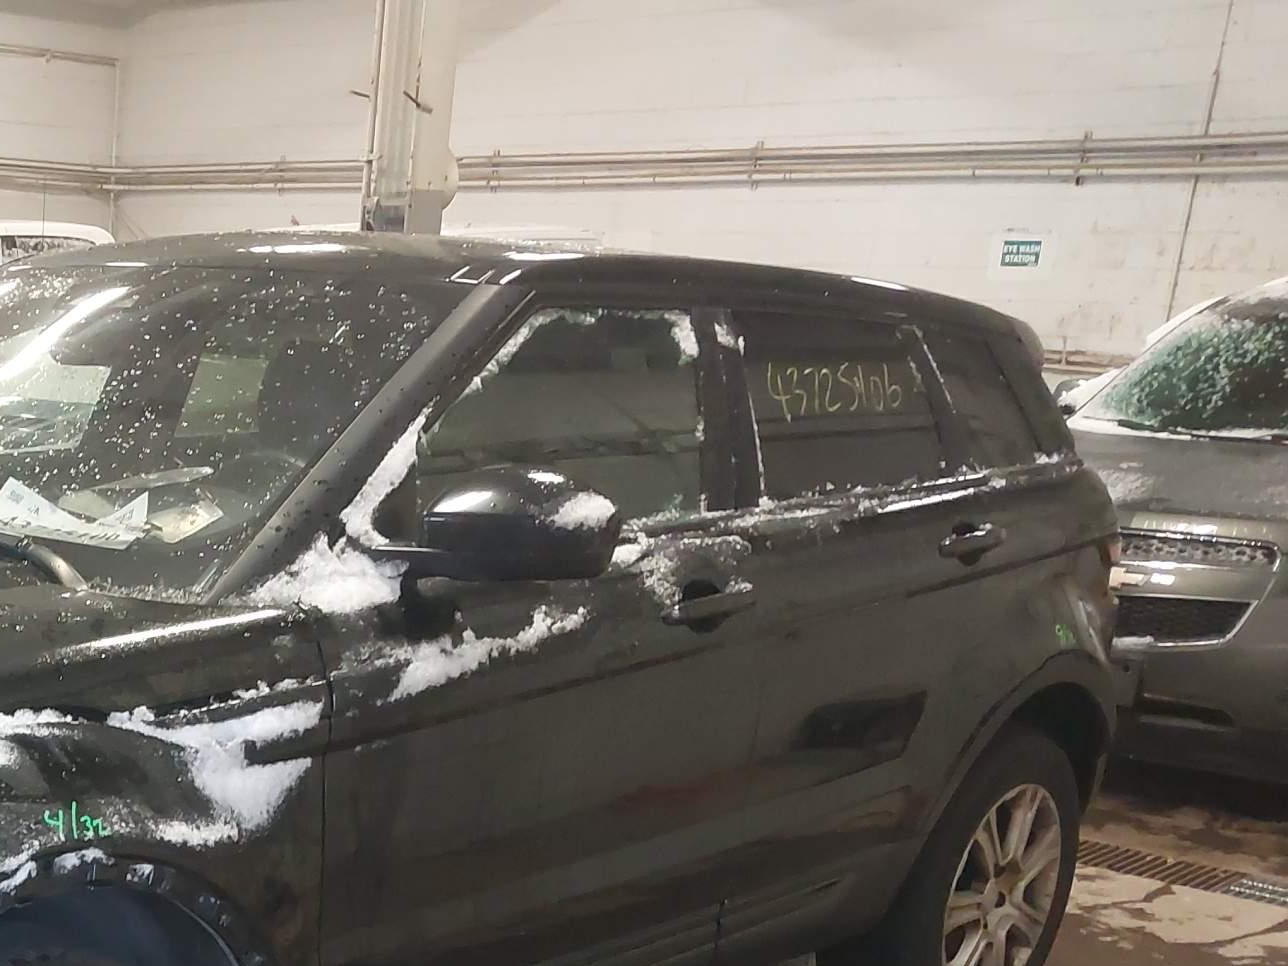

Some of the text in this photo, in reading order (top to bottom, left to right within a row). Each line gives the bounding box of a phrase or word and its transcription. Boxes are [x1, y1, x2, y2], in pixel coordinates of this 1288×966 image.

[1003, 244, 1040, 253] EYE WASH
[1005, 254, 1036, 263] STATION
